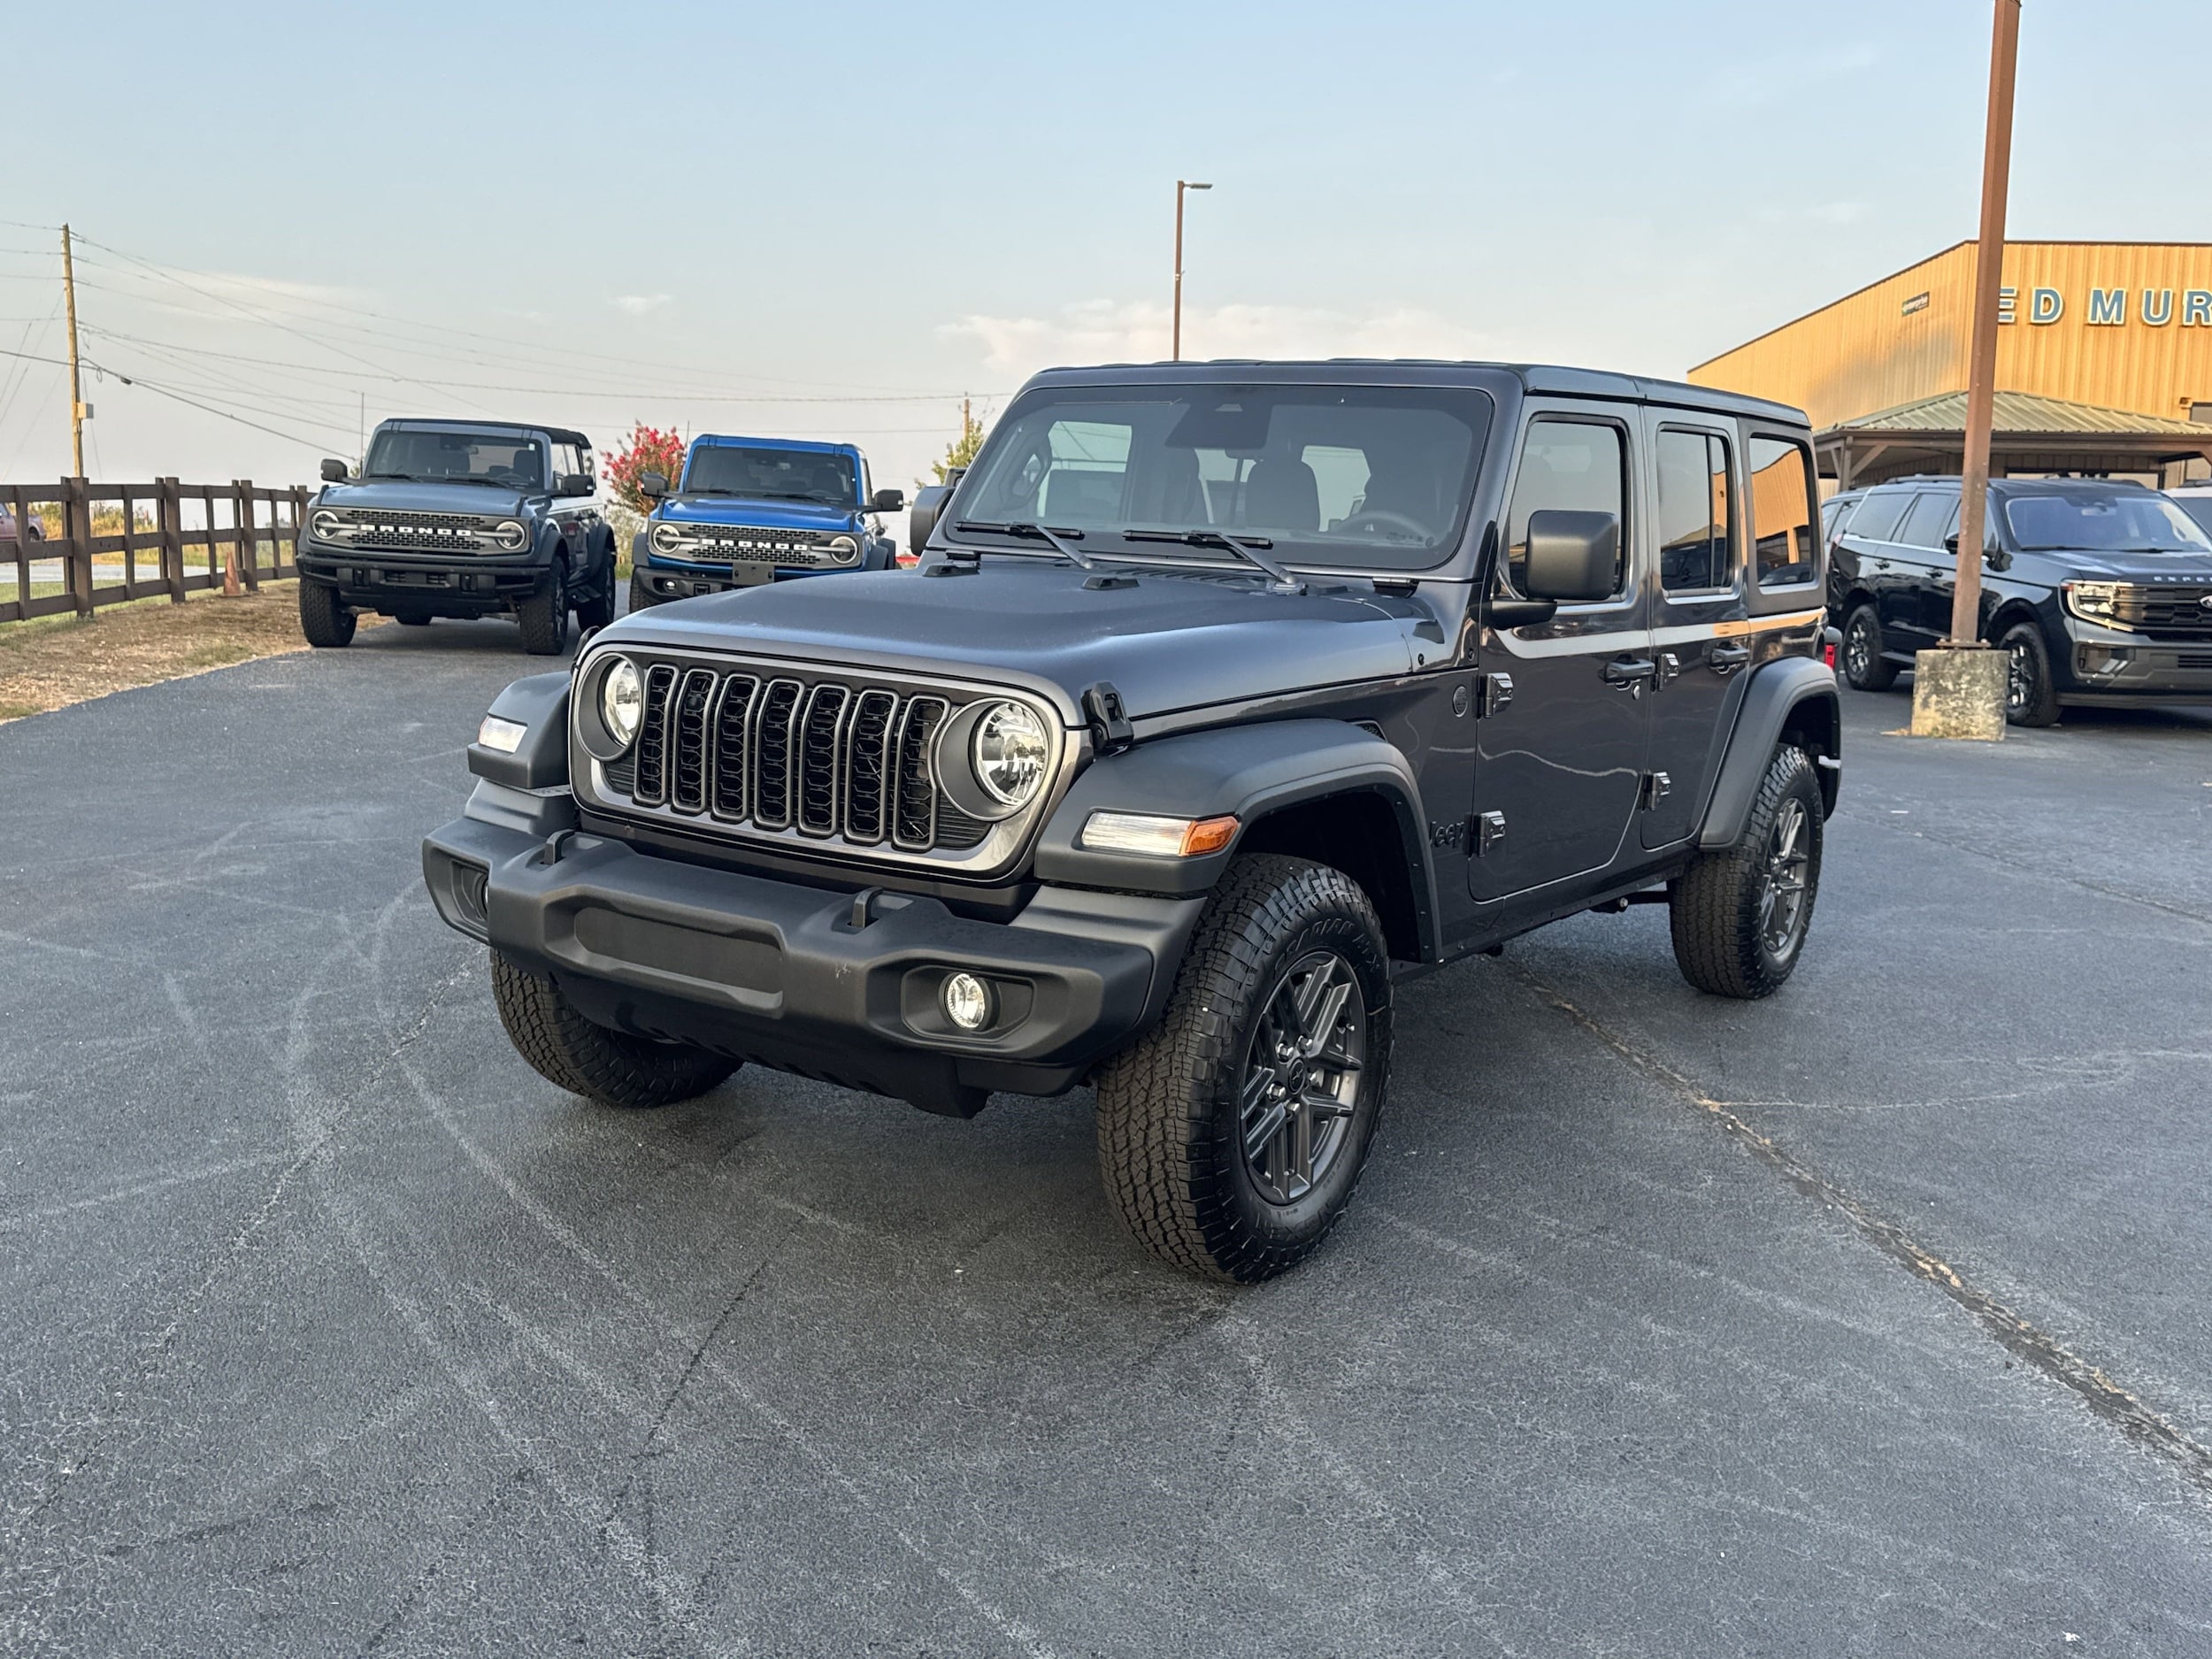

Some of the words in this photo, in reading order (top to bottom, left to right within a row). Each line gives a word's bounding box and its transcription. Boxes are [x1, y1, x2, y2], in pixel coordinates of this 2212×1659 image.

[360, 523, 472, 536] BRONCO
[700, 538, 808, 551] BRONCO
[1430, 820, 1464, 849] Jeep
